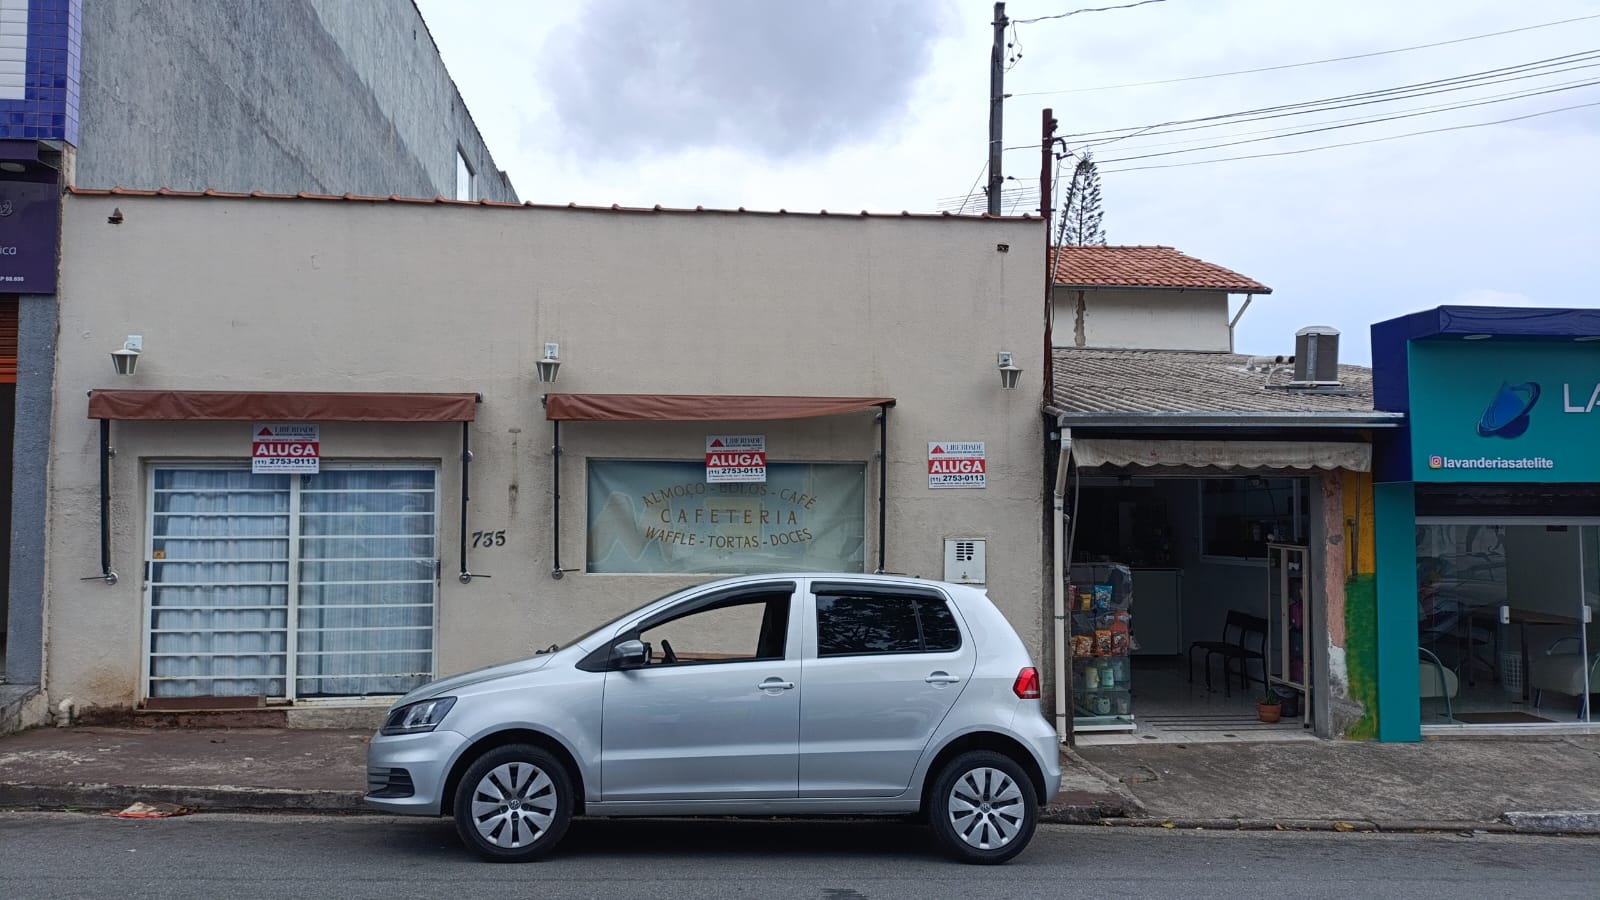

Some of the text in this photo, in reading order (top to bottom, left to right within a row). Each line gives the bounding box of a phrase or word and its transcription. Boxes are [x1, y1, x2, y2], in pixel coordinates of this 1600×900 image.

[255, 443, 316, 456] ALUGA
[709, 454, 763, 466] ALUGA
[930, 460, 984, 473] ALUGA
[1443, 456, 1554, 469] lavanderiasatelite
[942, 474, 985, 482] 2753-0113
[641, 483, 706, 507] ALMOÇO
[719, 483, 768, 497] BOLOS
[779, 488, 818, 510] CAFÉ
[660, 508, 798, 525] CAFETERIA
[472, 529, 506, 549] 735
[645, 526, 696, 546] WAFFLE
[707, 535, 760, 549] TORTAS
[770, 527, 813, 546] DOCES
